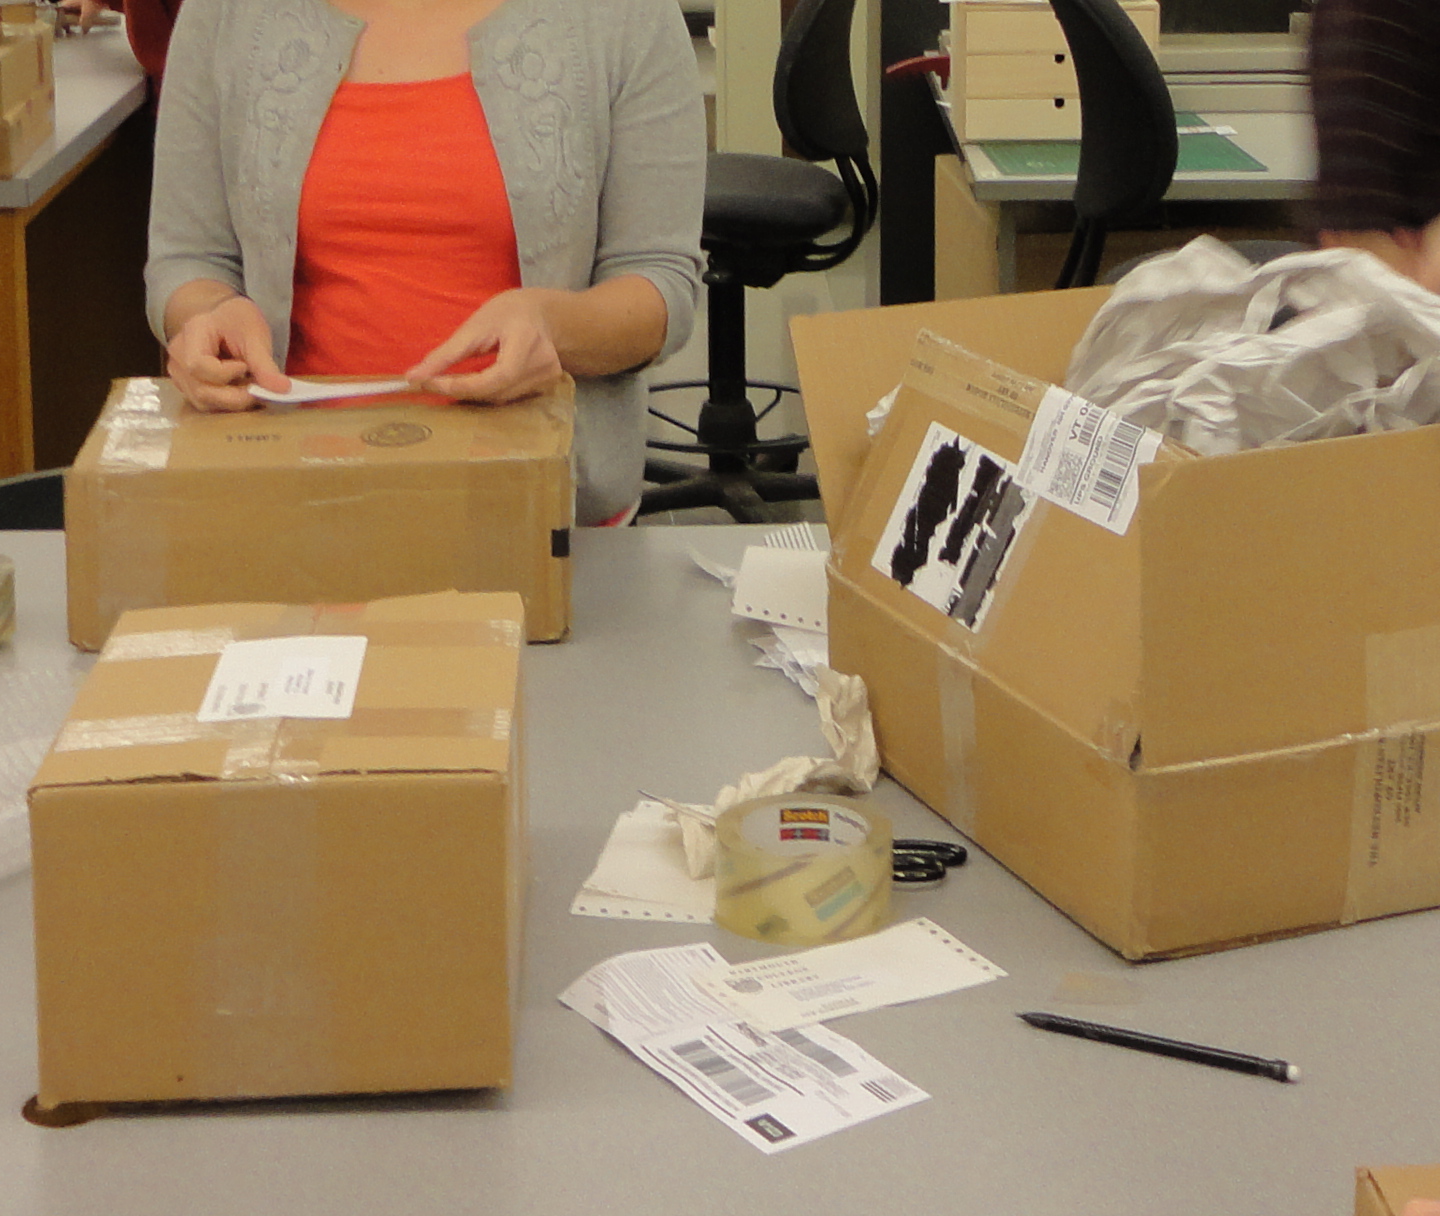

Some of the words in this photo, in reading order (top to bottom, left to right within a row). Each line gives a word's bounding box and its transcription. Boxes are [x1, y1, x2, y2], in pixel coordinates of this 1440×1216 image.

[1068, 418, 1082, 440] VT
[1073, 483, 1087, 505] UPS
[1083, 435, 1103, 482] GROUND
[782, 809, 828, 824] Scotch
